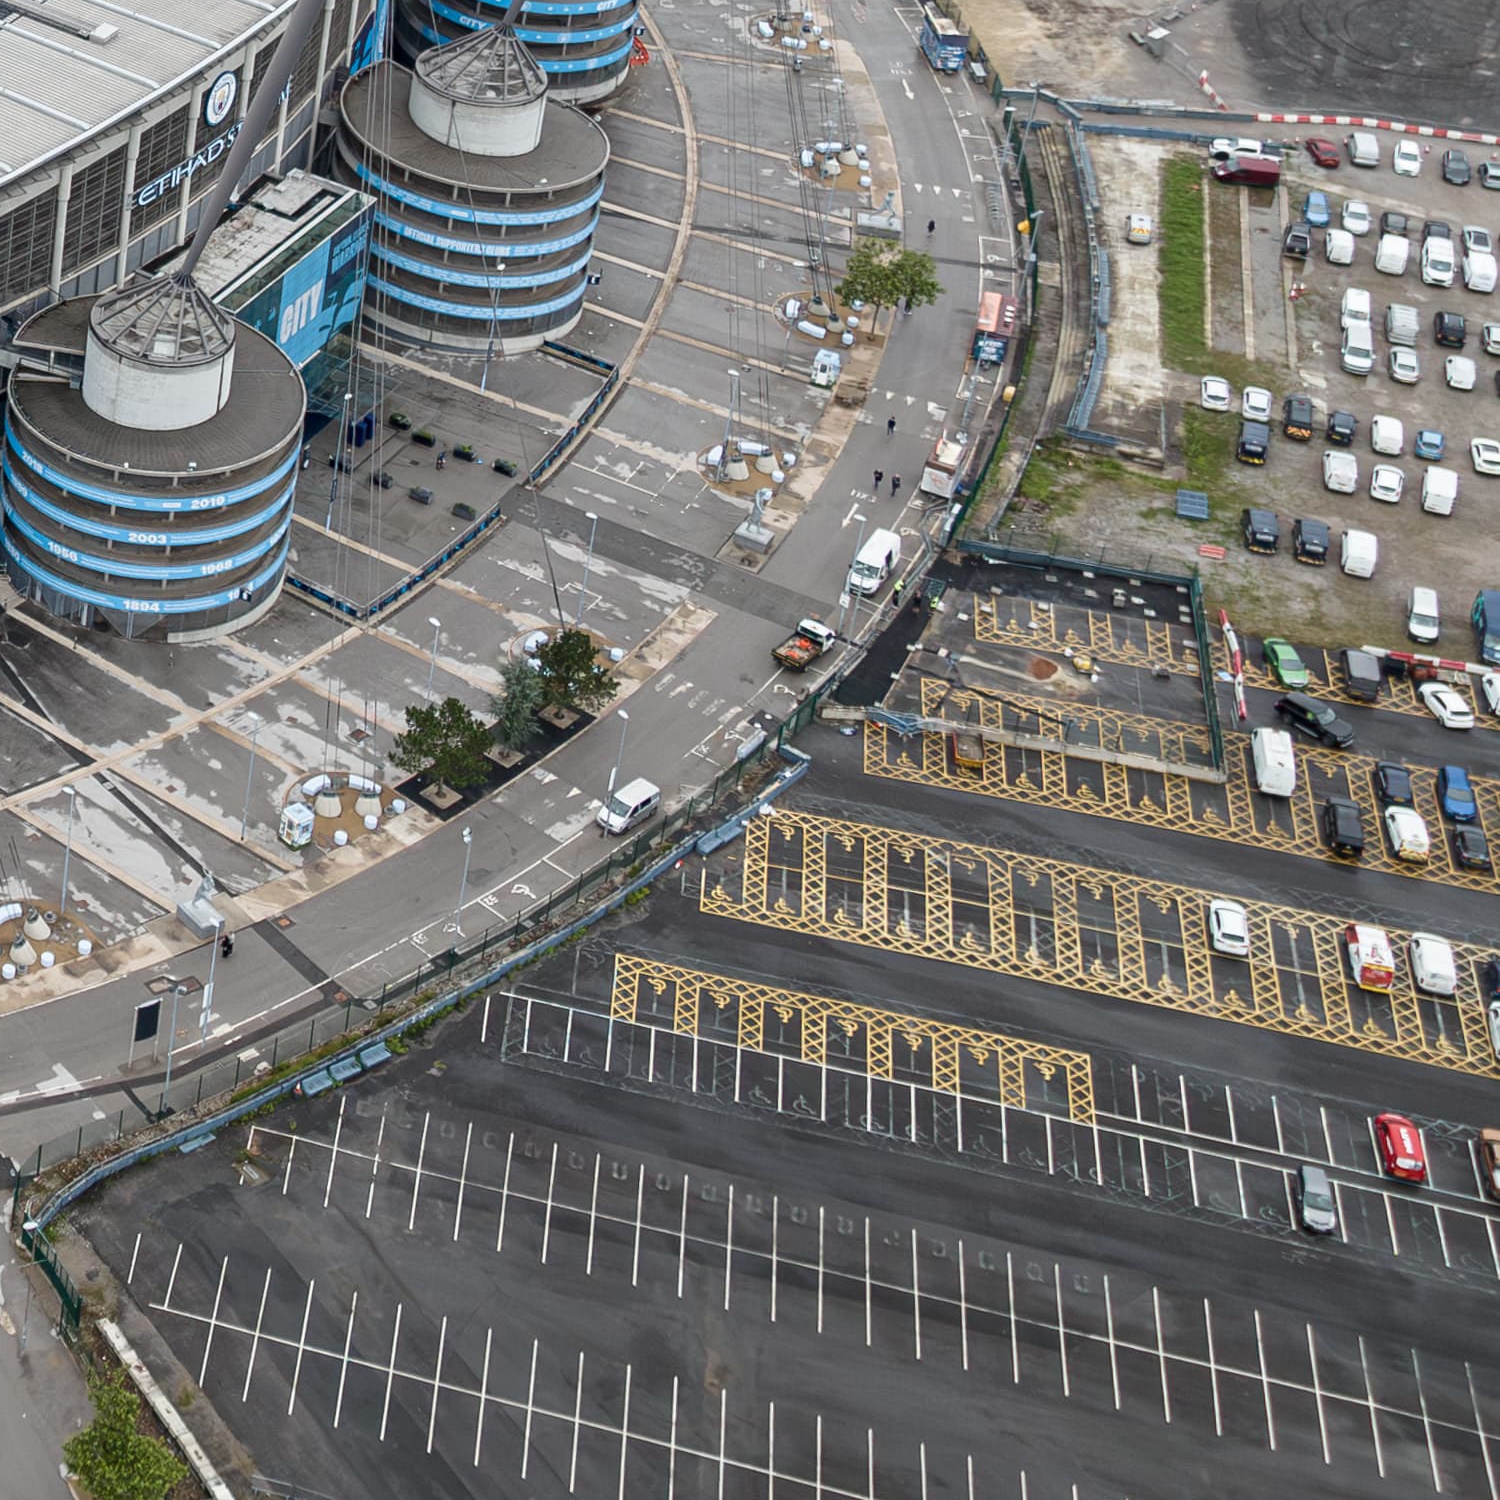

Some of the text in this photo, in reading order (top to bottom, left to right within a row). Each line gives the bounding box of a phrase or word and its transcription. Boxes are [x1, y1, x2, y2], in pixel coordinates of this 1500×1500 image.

[460, 16, 488, 29] CITY
[138, 140, 225, 207] ETIHAD
[280, 276, 325, 346] CITY
[128, 533, 167, 545] 2003
[123, 599, 160, 613] 1894
